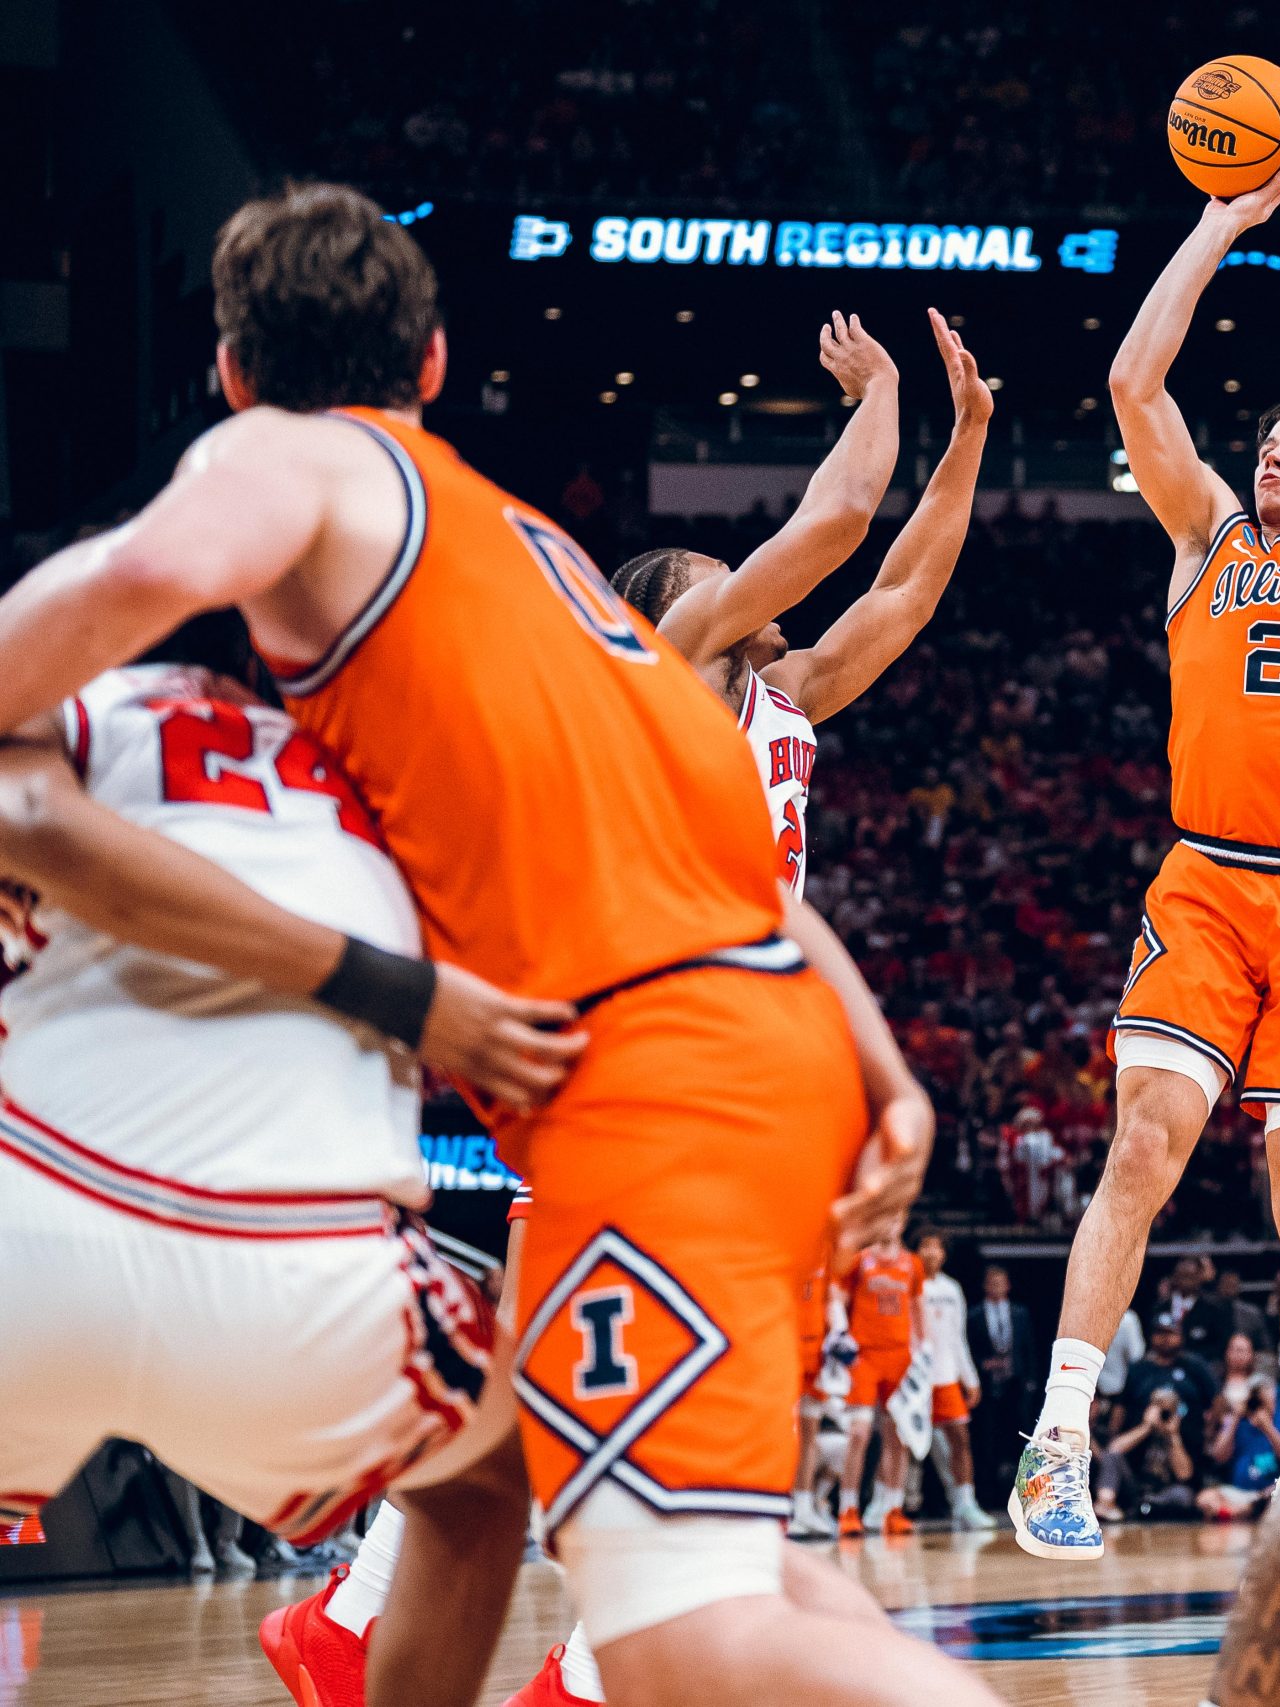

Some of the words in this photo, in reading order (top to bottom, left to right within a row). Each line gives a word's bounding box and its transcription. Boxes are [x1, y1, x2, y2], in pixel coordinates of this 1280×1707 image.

[1169, 107, 1237, 157] Wilson
[592, 218, 771, 263] SOUTH
[776, 222, 1041, 270] REGIONAL
